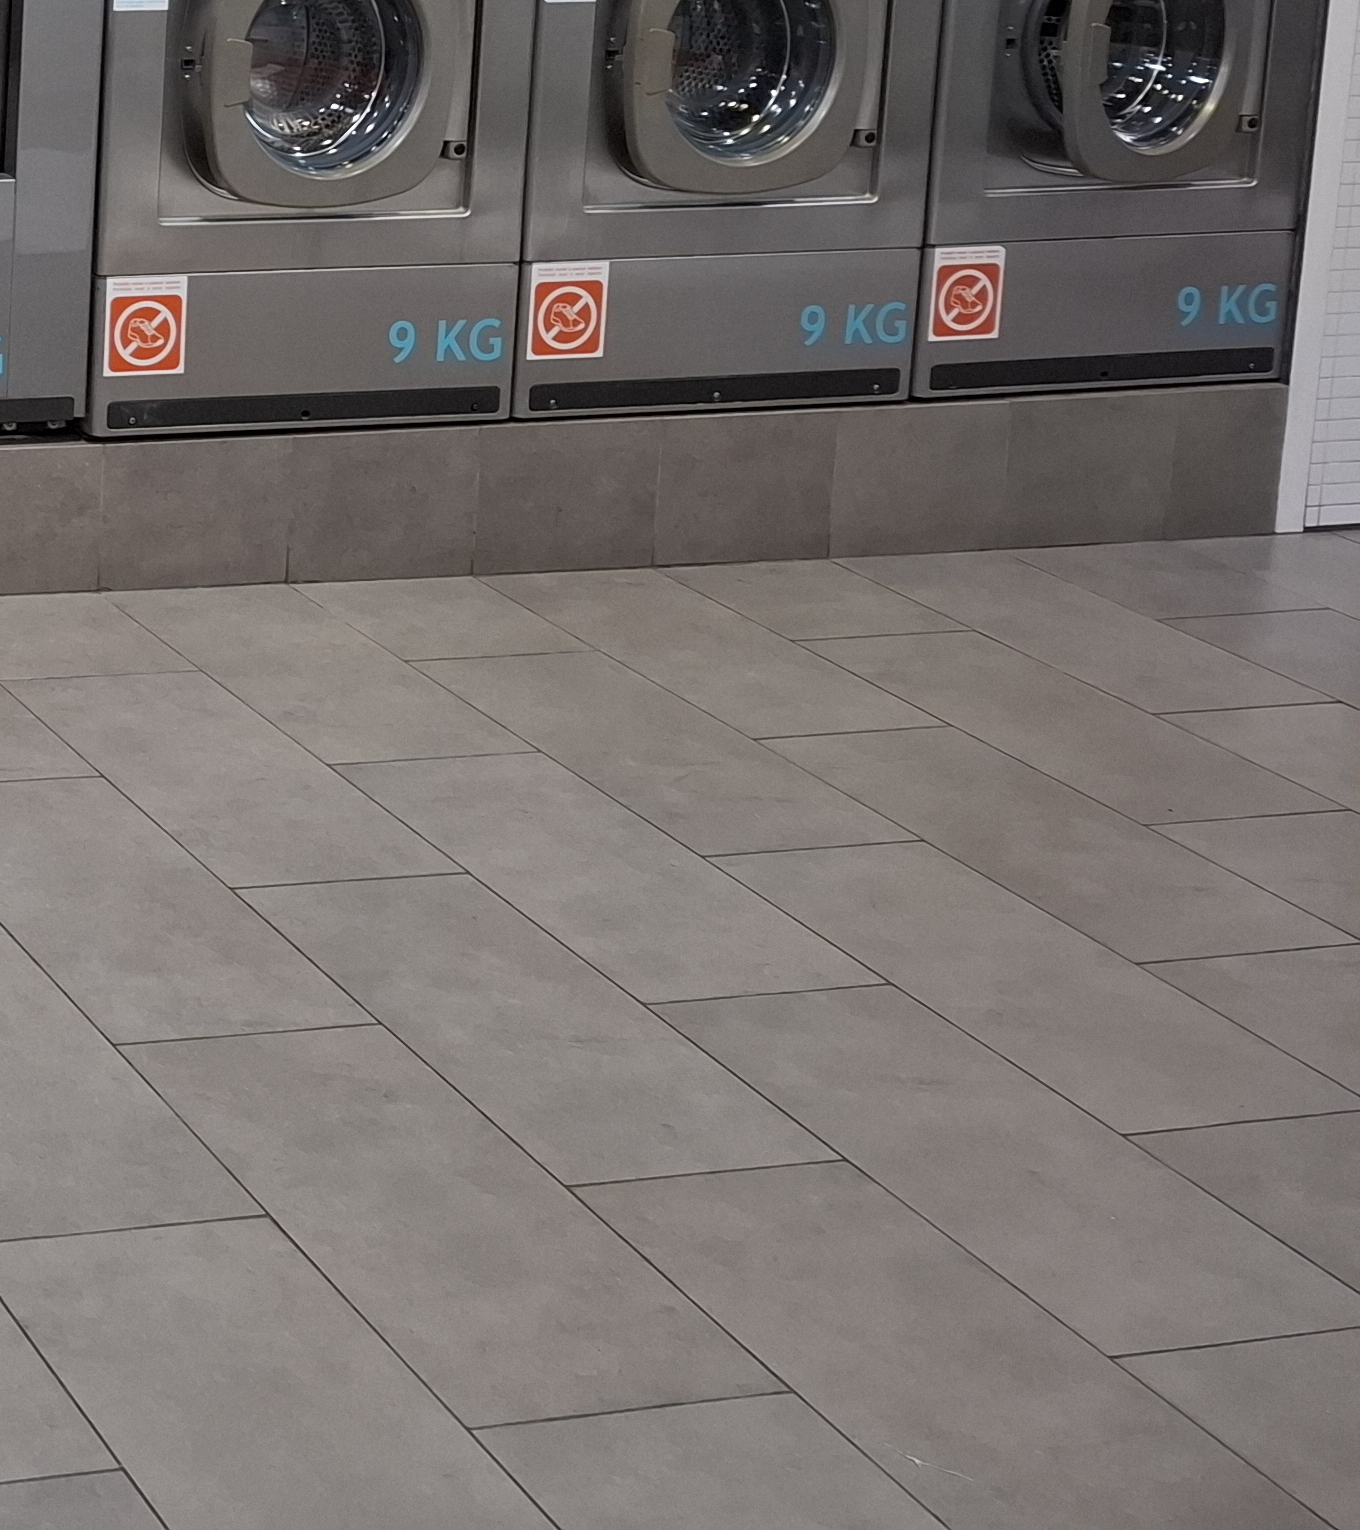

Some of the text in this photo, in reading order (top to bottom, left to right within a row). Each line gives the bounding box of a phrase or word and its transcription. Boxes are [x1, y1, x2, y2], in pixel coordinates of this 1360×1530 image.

[800, 301, 906, 345] 9 KG
[1177, 283, 1278, 326] 9 KG
[388, 318, 501, 363] 9 KG
